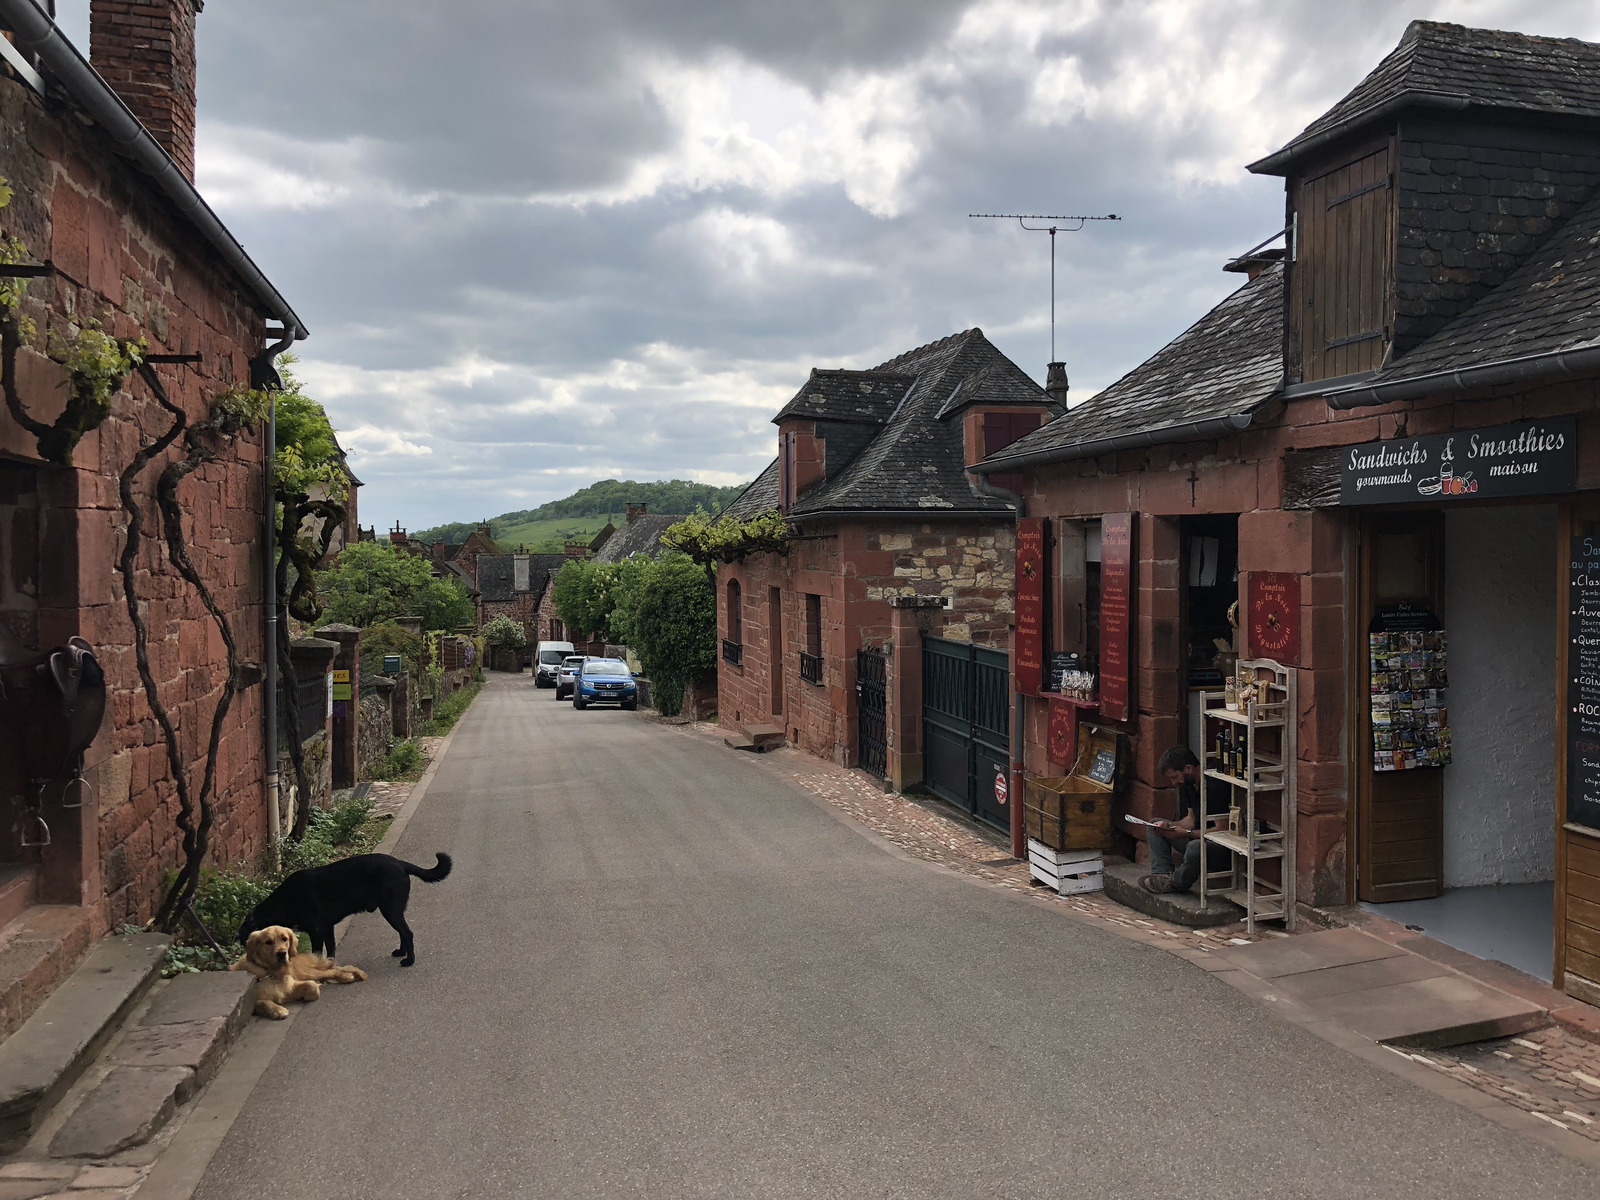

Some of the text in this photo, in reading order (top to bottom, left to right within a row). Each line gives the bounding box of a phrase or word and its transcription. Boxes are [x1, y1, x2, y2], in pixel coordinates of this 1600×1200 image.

[1348, 426, 1565, 471] Sandwichs & Smoothies
[1489, 460, 1539, 477] maison
[1356, 469, 1412, 492] gourmands
[1571, 561, 1584, 569] au
[1260, 581, 1286, 593] Comptoir
[1577, 574, 1600, 587] Clas
